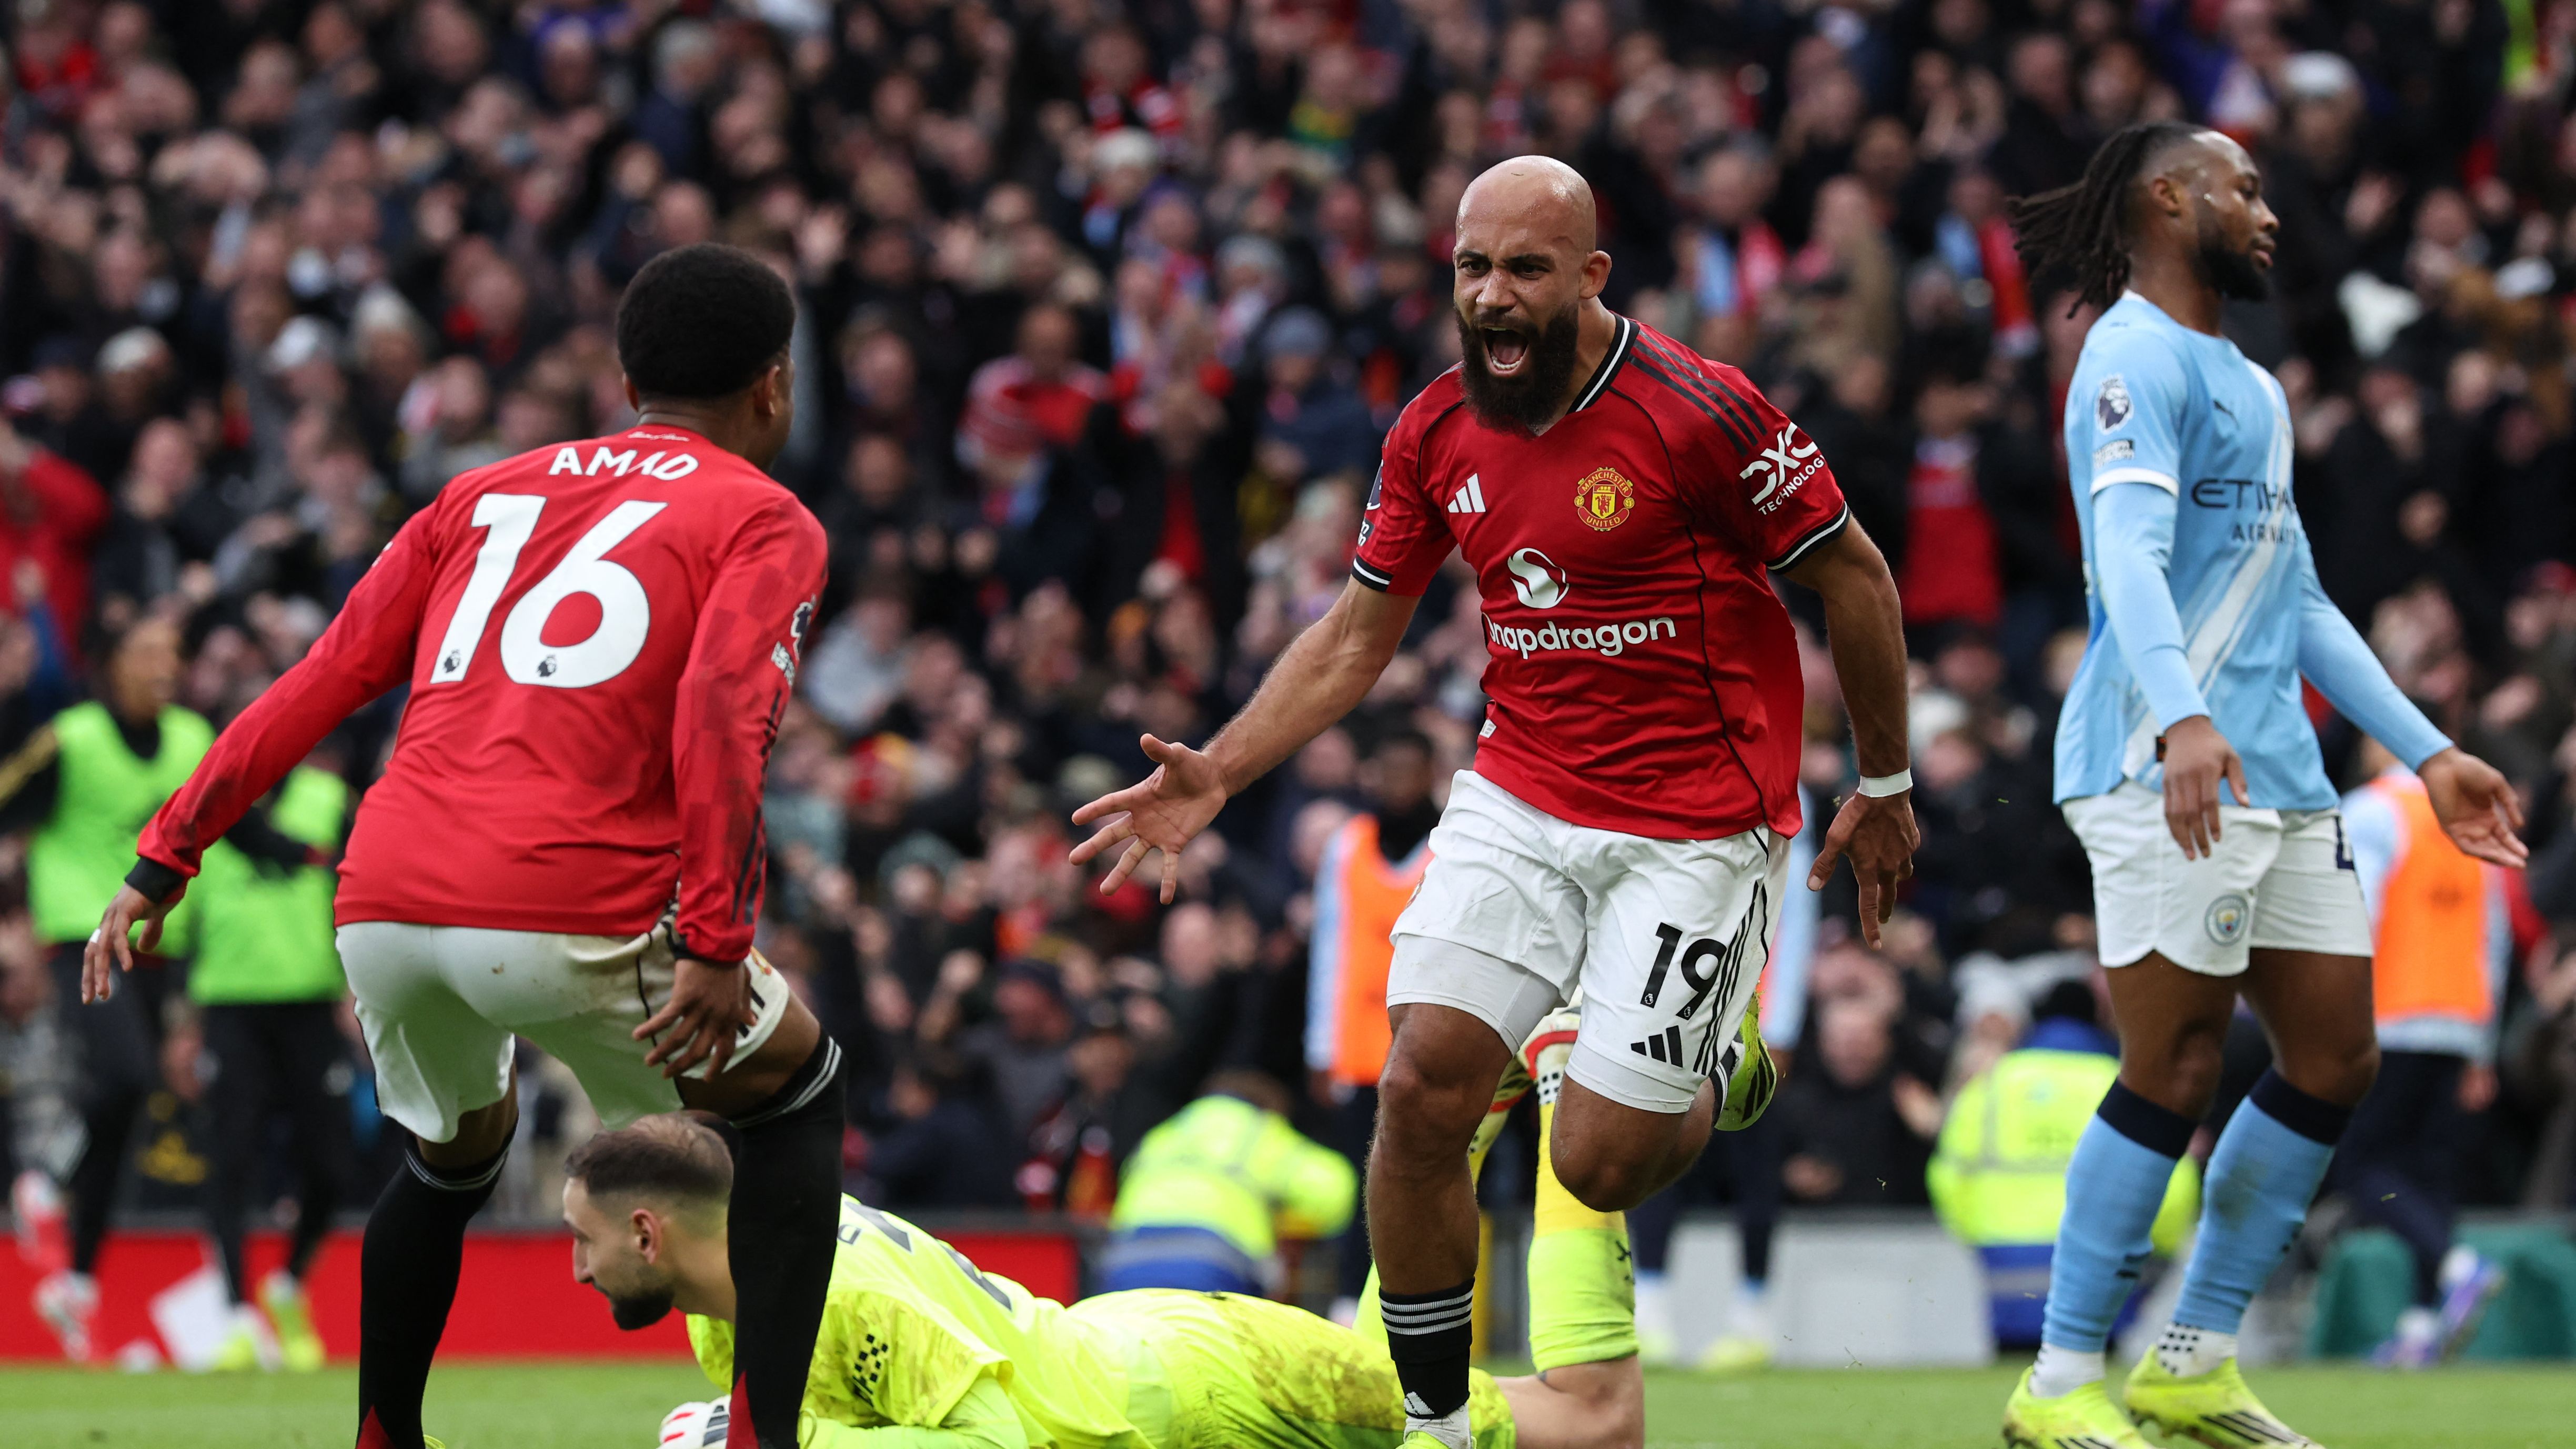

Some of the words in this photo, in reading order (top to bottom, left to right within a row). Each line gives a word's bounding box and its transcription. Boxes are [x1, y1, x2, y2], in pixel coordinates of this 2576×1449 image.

[548, 446, 699, 481] AMAD
[1739, 421, 1818, 505] DXC
[1582, 471, 1629, 494] MANCHESTER
[2190, 478, 2297, 514] ETIHA
[1586, 516, 1621, 527] UNITED
[430, 492, 669, 688] 16
[1640, 922, 1727, 1021] 19
